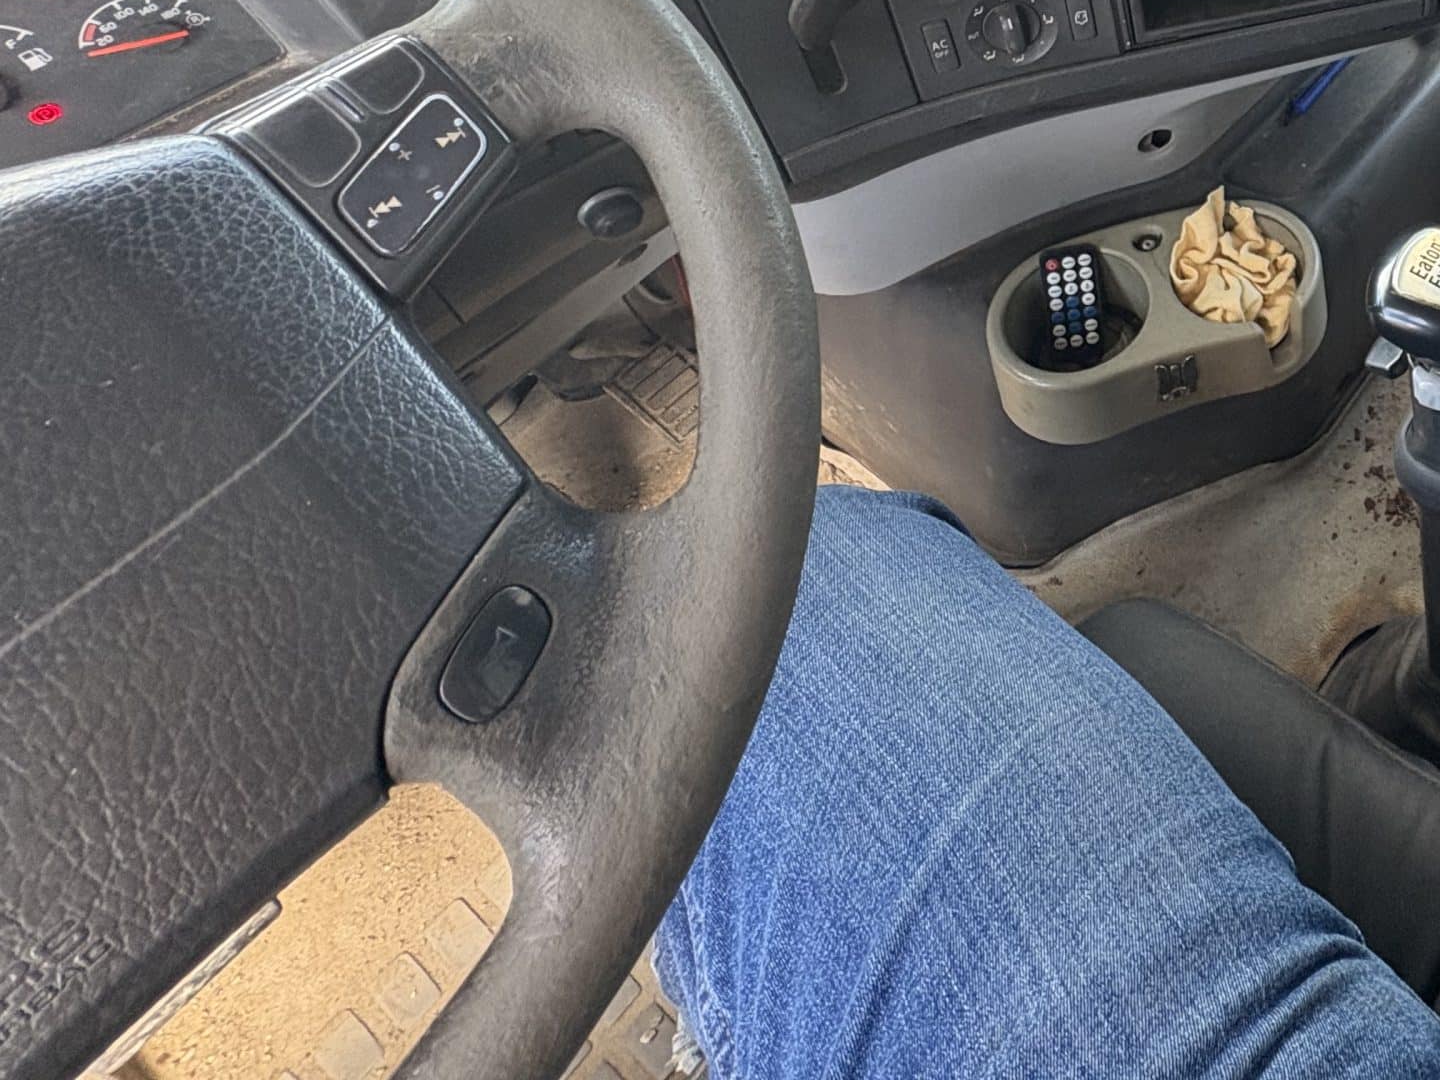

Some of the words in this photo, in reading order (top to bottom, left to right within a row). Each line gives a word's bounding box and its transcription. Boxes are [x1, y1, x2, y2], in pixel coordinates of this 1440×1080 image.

[113, 7, 135, 21] 100
[96, 34, 115, 48] 20
[932, 40, 949, 51] AC
